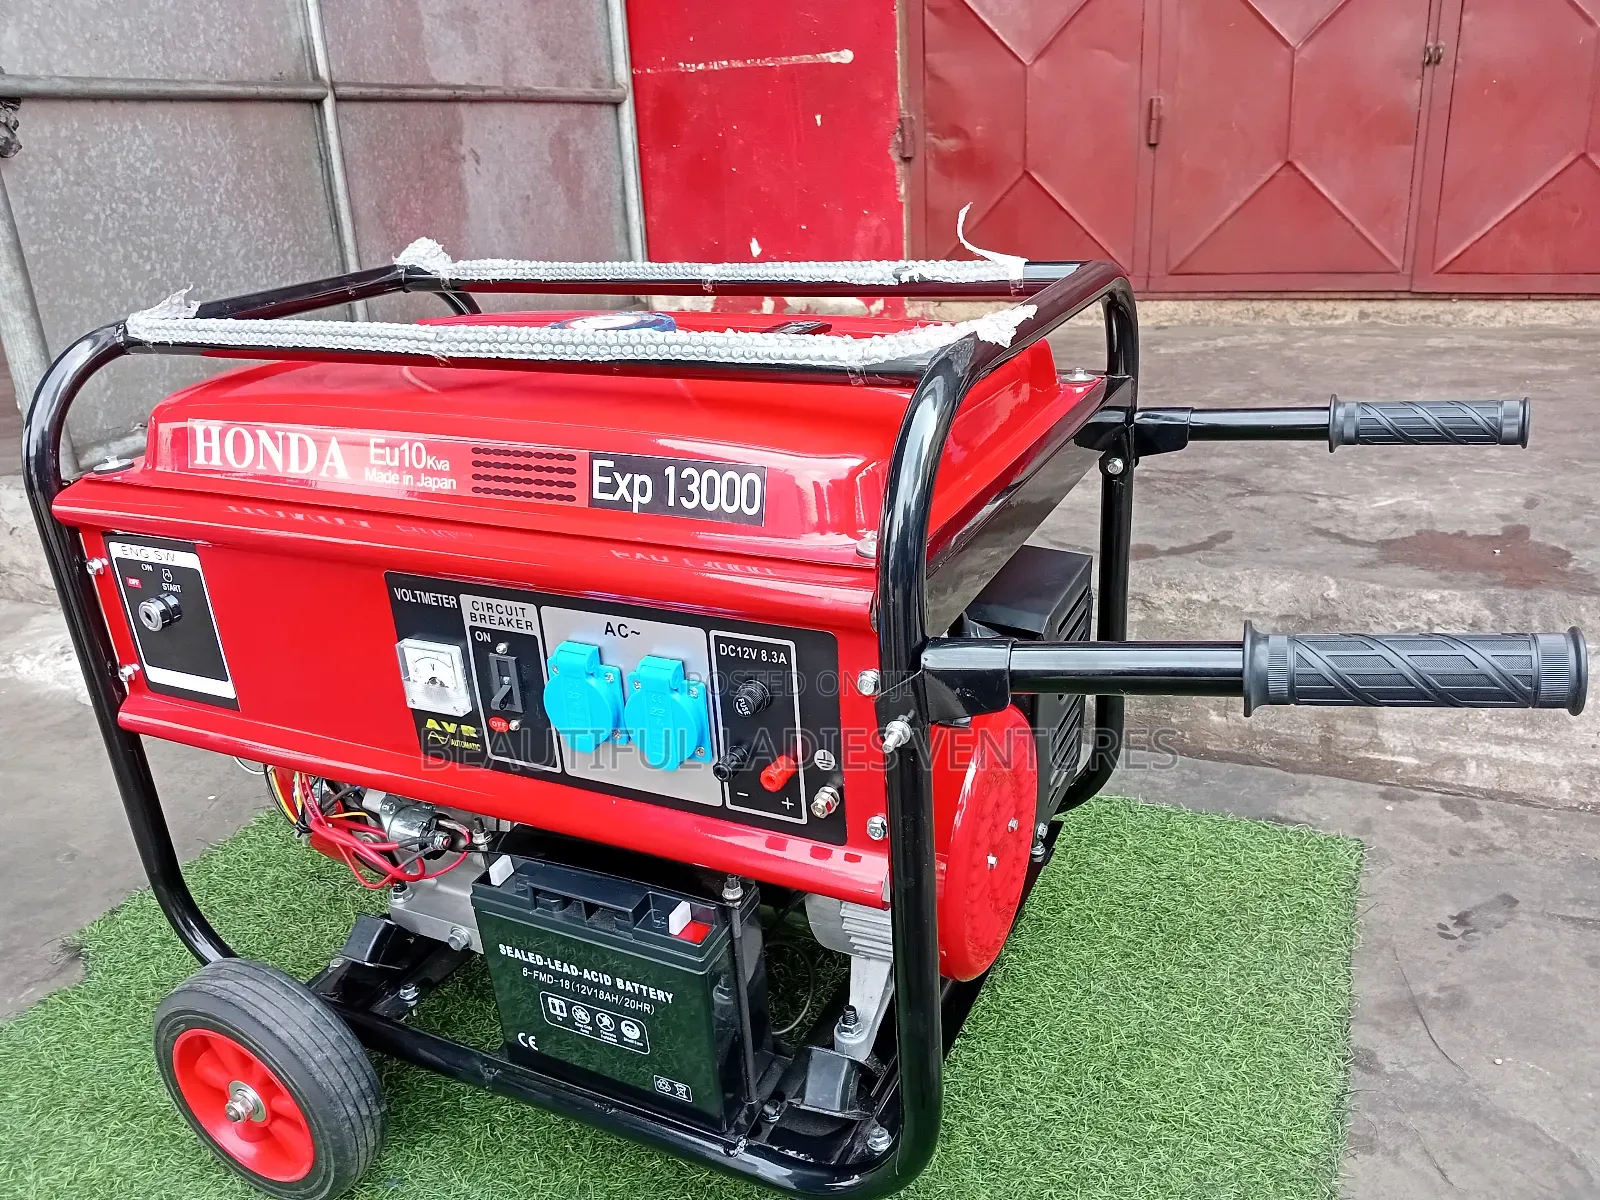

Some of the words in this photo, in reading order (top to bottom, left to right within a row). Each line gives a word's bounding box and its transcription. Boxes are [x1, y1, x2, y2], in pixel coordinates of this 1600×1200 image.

[193, 424, 350, 480] HONDA
[365, 467, 400, 484] Made
[402, 473, 414, 486] in
[416, 474, 456, 490] Japan
[592, 460, 653, 513] Exp
[664, 465, 762, 516] 13000
[121, 545, 149, 558] ENG
[154, 550, 175, 562] SW
[141, 563, 153, 571] ON
[162, 582, 182, 592] START
[394, 587, 458, 608] VOLTMETER
[471, 600, 526, 618] CIRCUIT
[470, 612, 534, 631] BREAKER
[474, 630, 492, 643] ON
[719, 643, 757, 660] DC12V
[760, 649, 787, 665] 8.3A
[737, 697, 751, 716] FUSE
[426, 718, 479, 738] AVR
[491, 720, 508, 729] OFF
[451, 738, 481, 752] AUTOMATIC
[498, 943, 612, 986] SEALED-LEAD-ACID
[615, 977, 673, 1004] BATTERY
